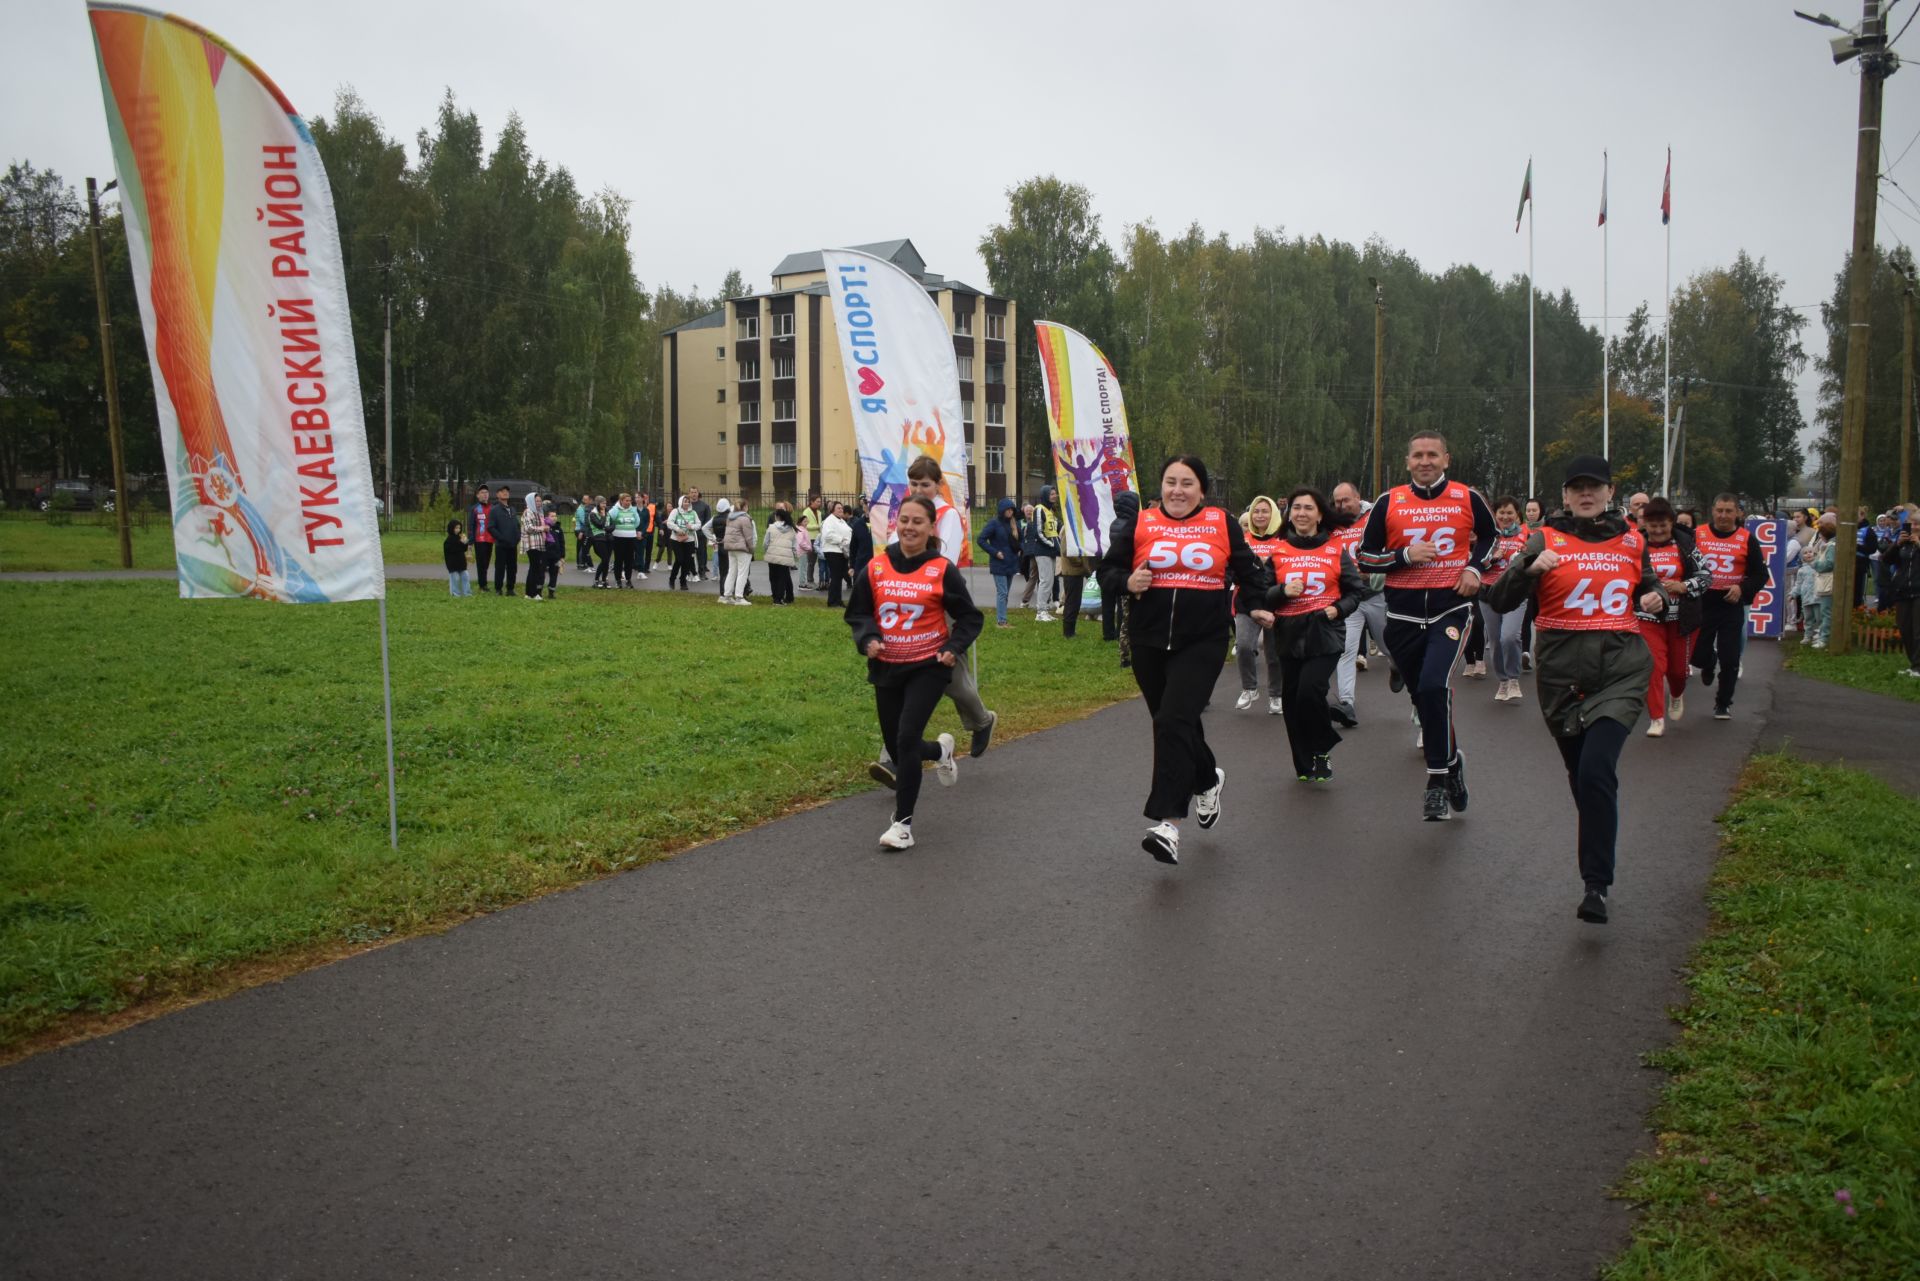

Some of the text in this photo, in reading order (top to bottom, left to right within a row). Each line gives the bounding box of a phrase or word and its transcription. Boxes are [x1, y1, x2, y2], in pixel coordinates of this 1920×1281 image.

[257, 145, 344, 554] ТУКАЕВСКИЙ РАЙОН
[839, 265, 888, 414] Я СПОРТ!
[1096, 367, 1112, 415] СПОРТА!
[1398, 505, 1462, 515] ТУКАЕВСКИЙ
[1412, 514, 1448, 523] РАЙОН
[1149, 541, 1214, 571] 56
[1281, 555, 1332, 565] ТУКАЕВСКИЙ
[1578, 561, 1619, 571] РАЙОН
[1702, 553, 1735, 573] 63
[884, 588, 918, 598] РАЙОН
[1564, 578, 1629, 616] 46
[879, 602, 925, 631] 67
